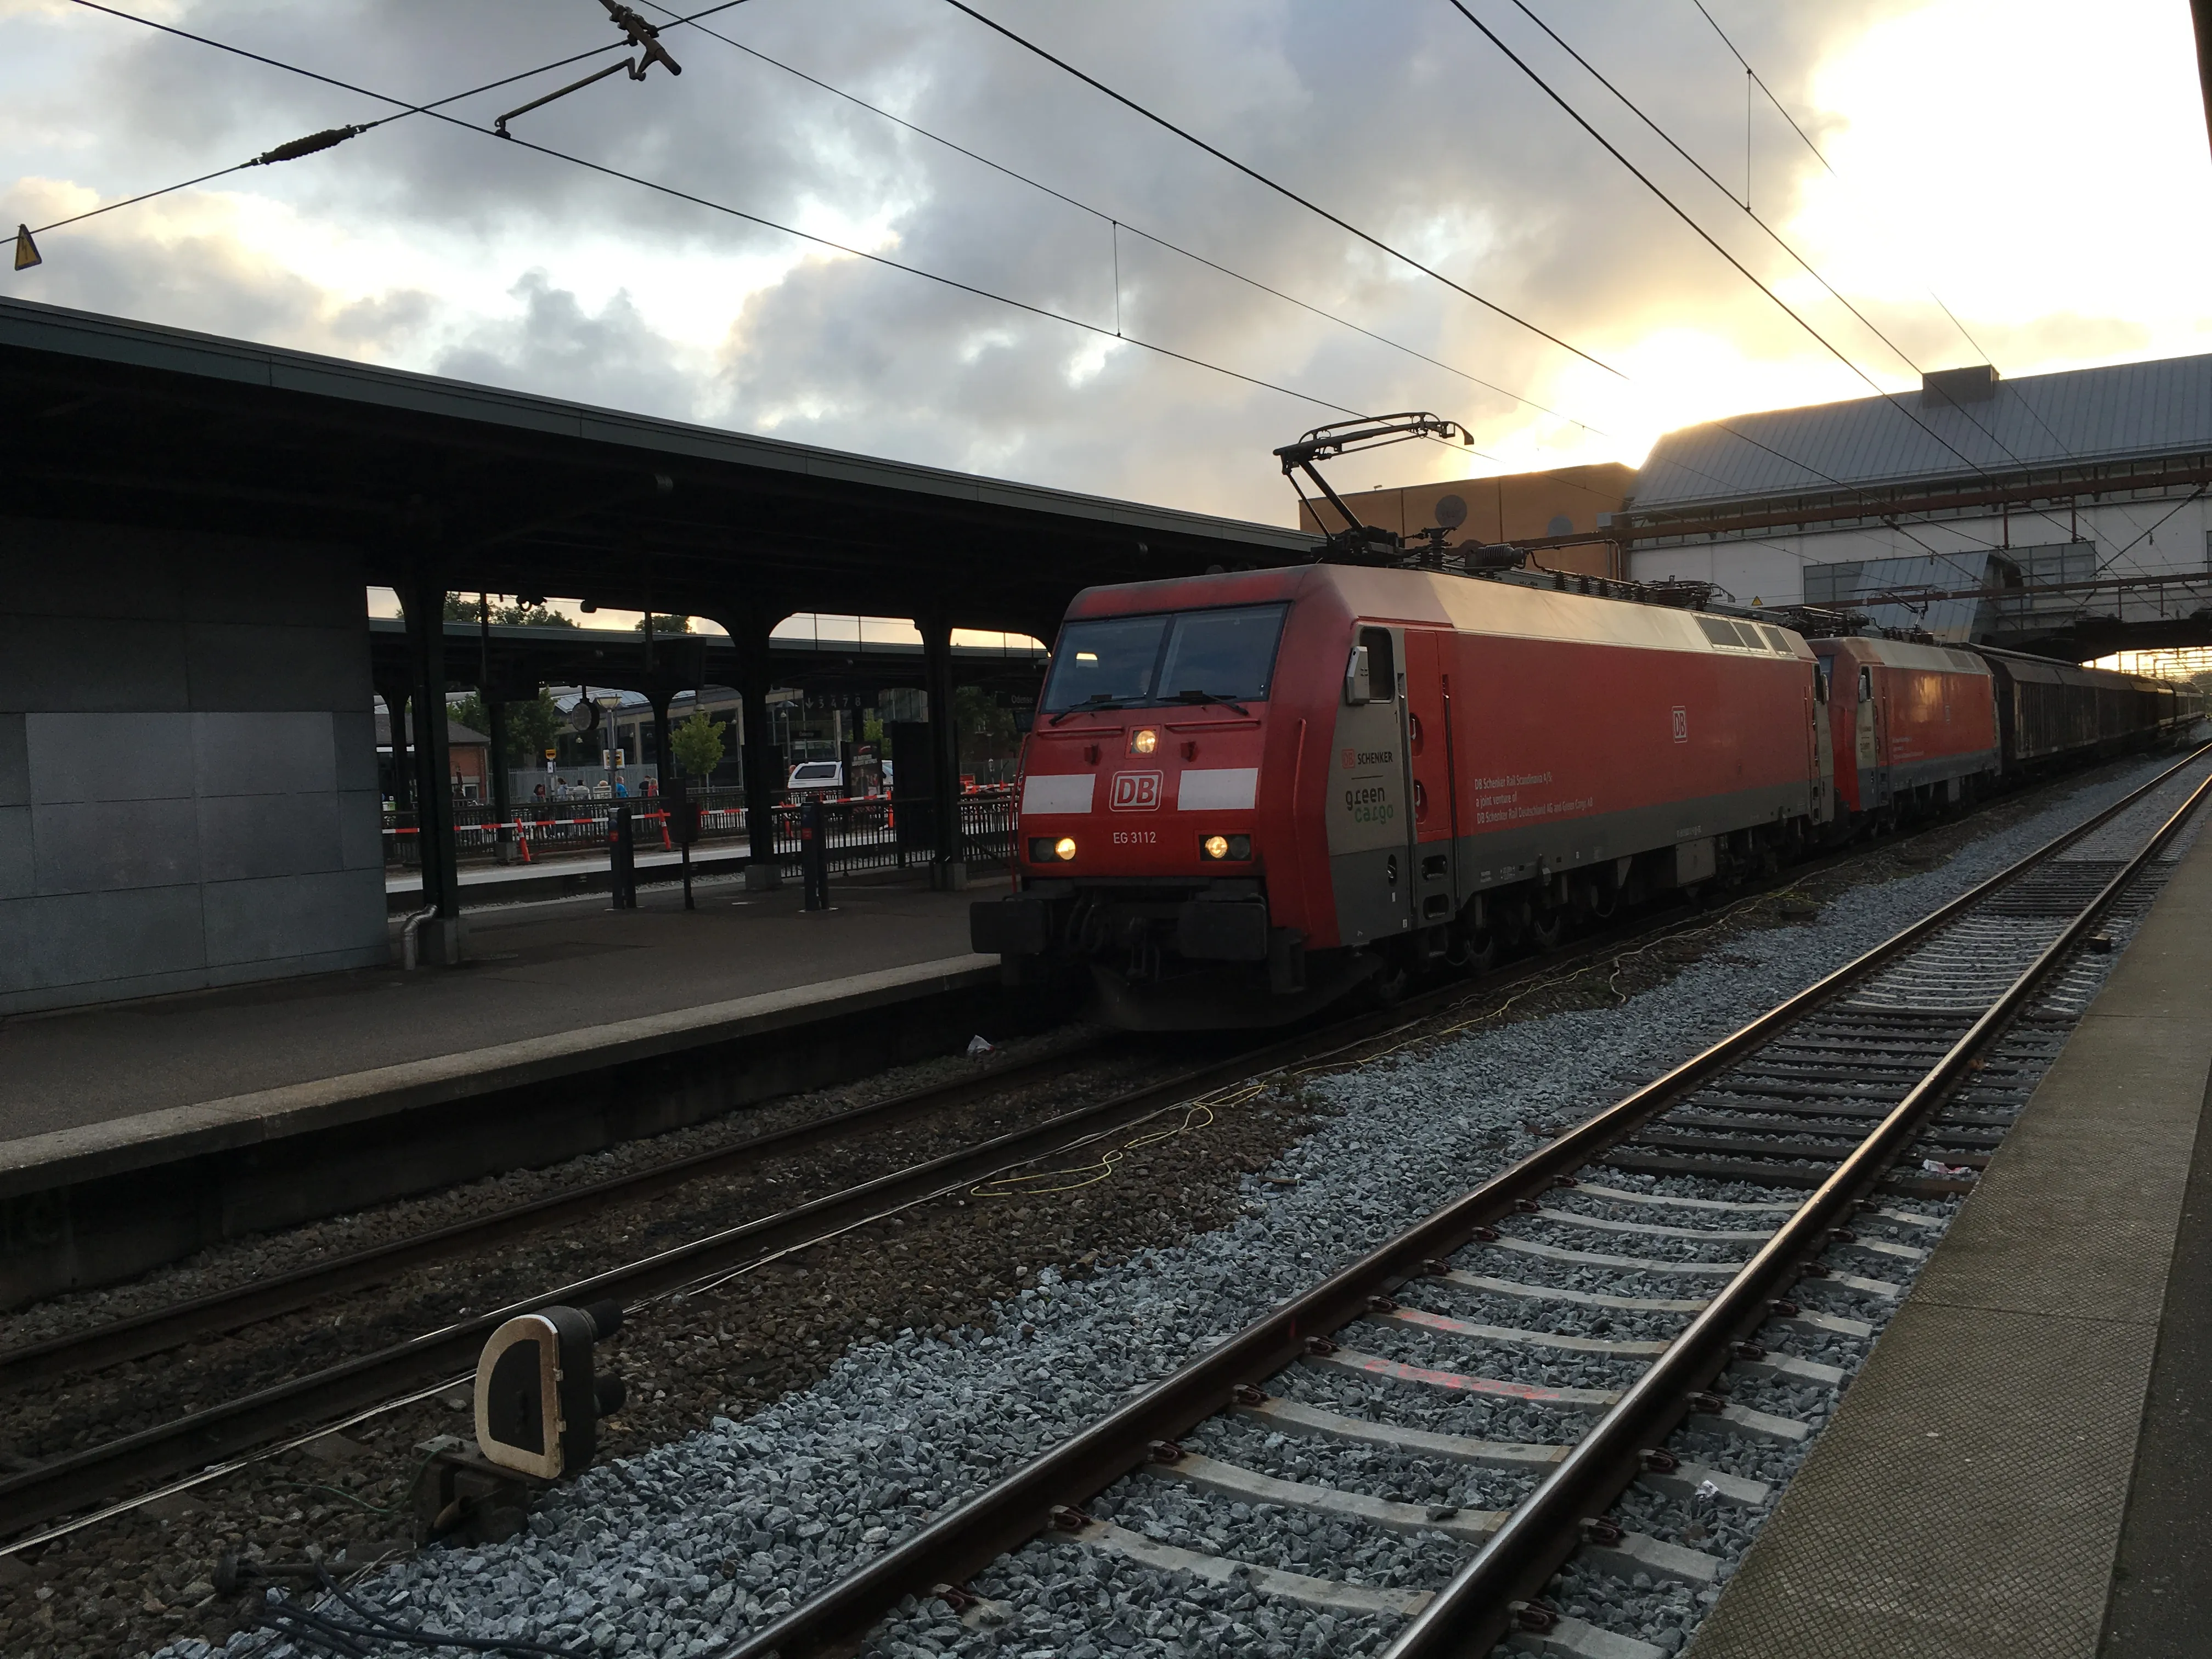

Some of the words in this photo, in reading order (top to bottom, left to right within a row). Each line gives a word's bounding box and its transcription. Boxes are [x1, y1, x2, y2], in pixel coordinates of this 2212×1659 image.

[818, 698, 825, 708] 3
[831, 698, 837, 708] 4
[843, 697, 849, 707] 7
[855, 696, 861, 707] 8
[1011, 695, 1034, 704] Odense
[1674, 712, 1686, 737] DB
[1342, 751, 1354, 768] DB
[1357, 751, 1393, 765] SCHENKER
[1115, 776, 1156, 805] DB
[1474, 778, 1482, 790] DB
[1483, 777, 1505, 789] Schenker
[1506, 775, 1516, 786] Rail
[1346, 787, 1385, 811] green
[1476, 798, 1480, 808] a
[1480, 795, 1492, 809] joint
[1492, 794, 1511, 805] venture
[1511, 791, 1517, 803] of
[1355, 804, 1393, 825] cargo
[1477, 812, 1485, 824] DB
[1486, 810, 1508, 823] Schenker
[1508, 808, 1518, 819] Rail
[1519, 804, 1547, 817] Deutschland
[1113, 832, 1128, 844] EG
[1131, 831, 1156, 844] 3112
